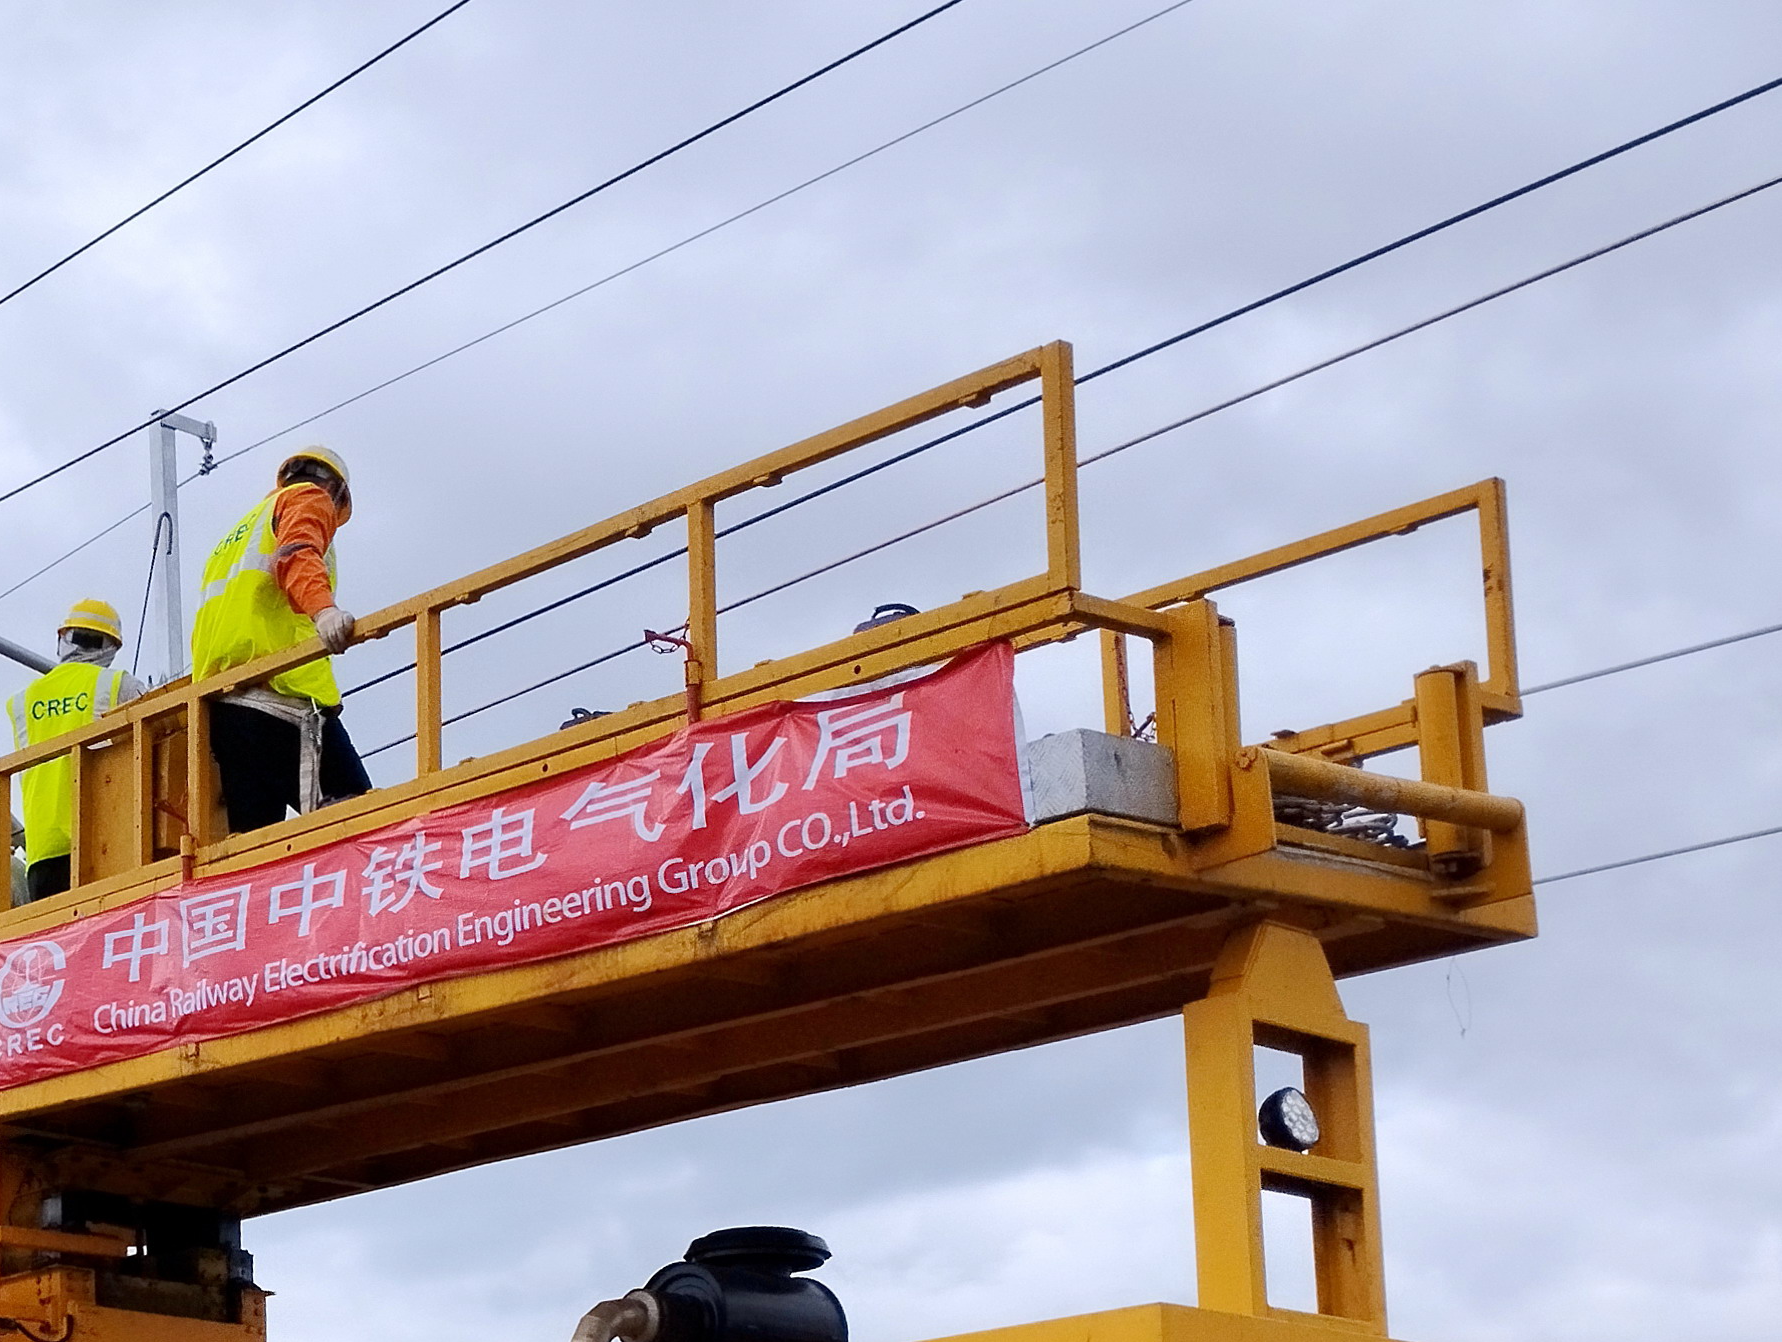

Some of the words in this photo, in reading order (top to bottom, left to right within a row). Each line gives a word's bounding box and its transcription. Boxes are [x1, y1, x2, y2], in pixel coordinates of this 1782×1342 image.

[31, 692, 89, 720] CREC
[102, 690, 913, 983] 中国中铁电气化局
[93, 998, 168, 1035] China
[169, 973, 258, 1017] Railway
[264, 928, 452, 995] Electrification
[457, 875, 651, 947] Engineering
[658, 838, 771, 894] Group
